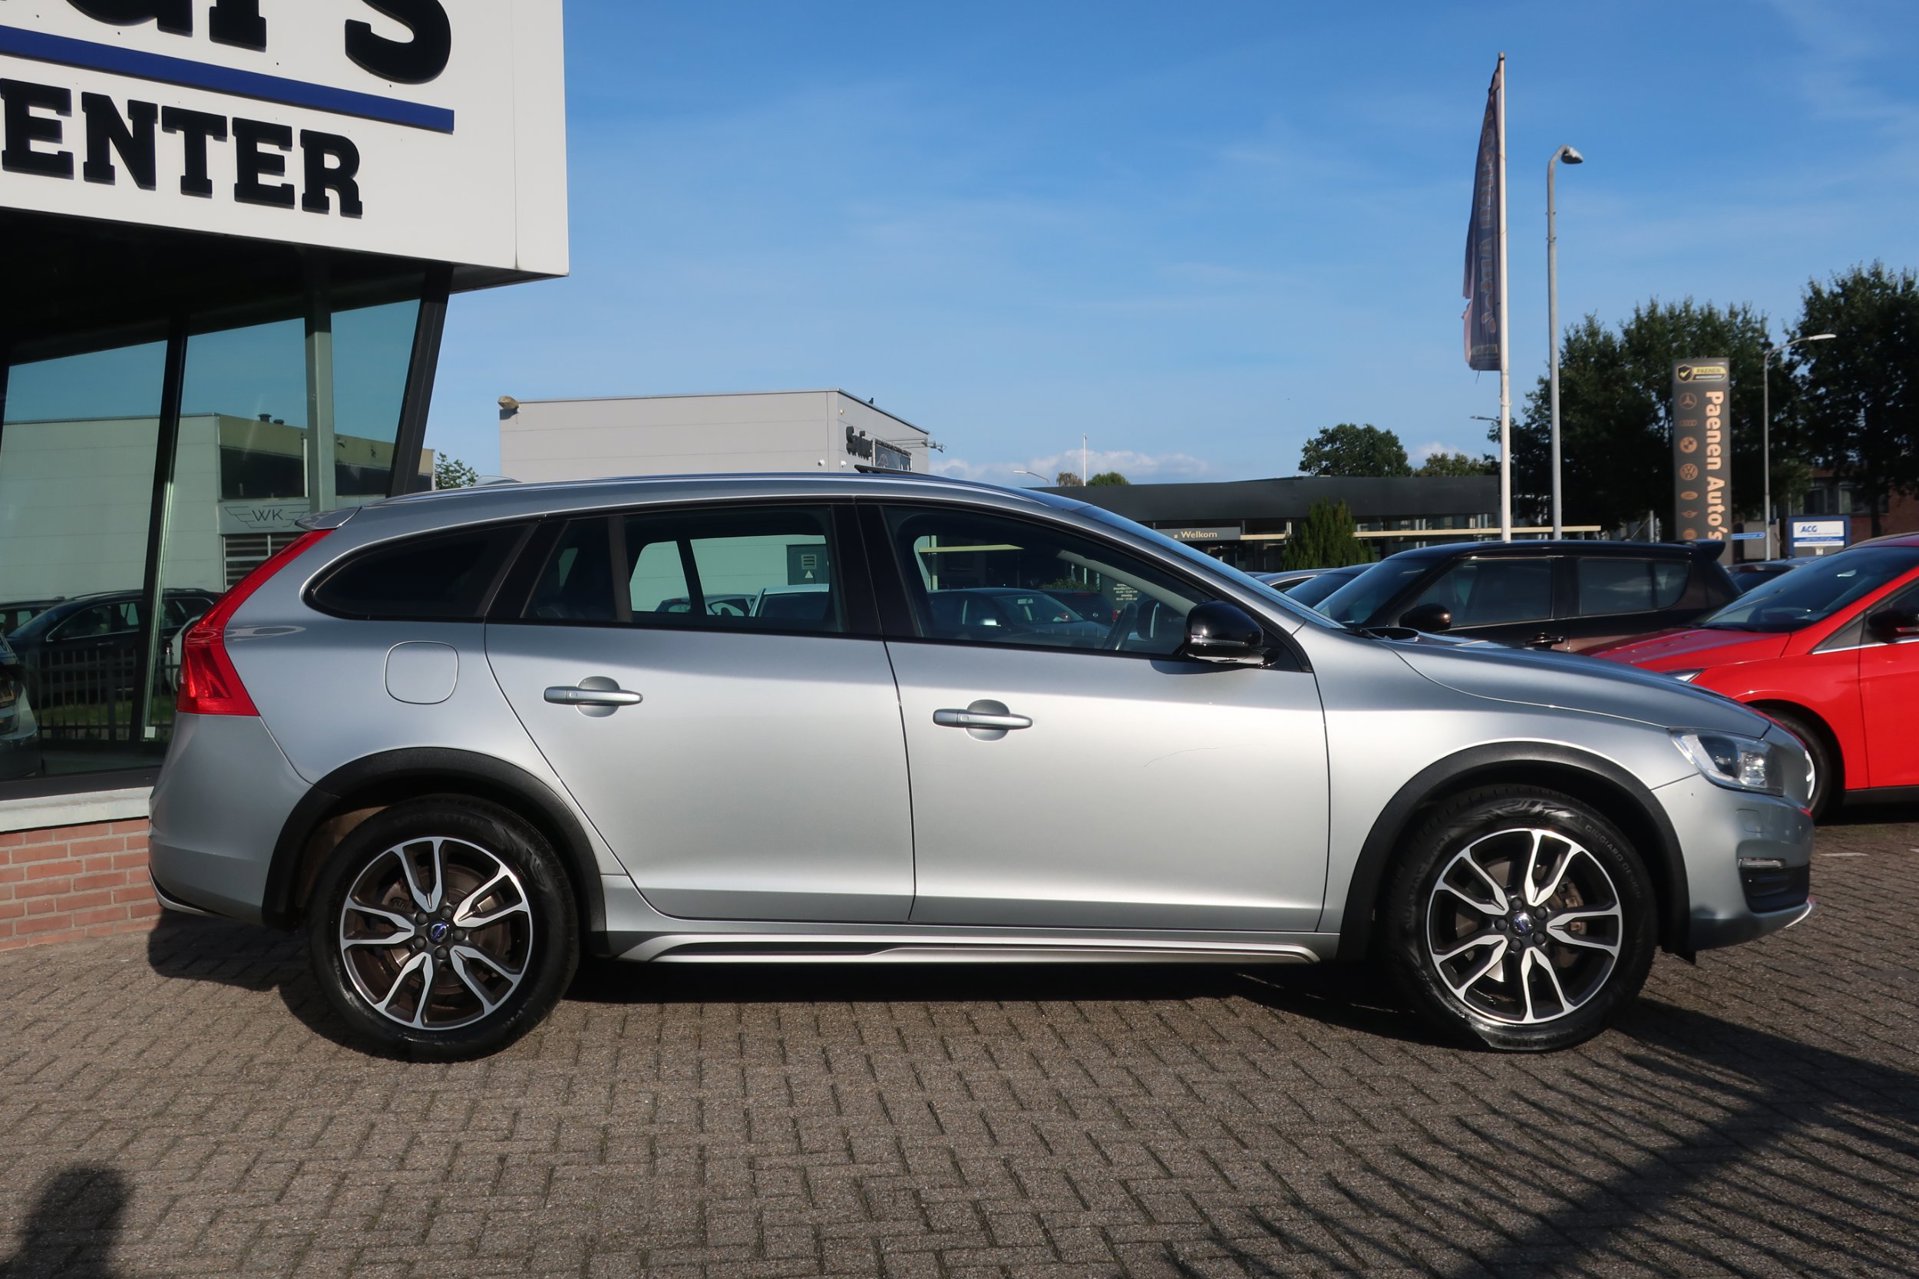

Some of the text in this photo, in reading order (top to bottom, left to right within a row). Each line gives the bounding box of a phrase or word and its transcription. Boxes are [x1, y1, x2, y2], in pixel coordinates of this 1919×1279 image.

[1705, 391, 1725, 471] Paenen
[251, 508, 284, 522] WK
[1706, 475, 1729, 541] Auto's
[1180, 530, 1218, 539] Welkom
[1801, 525, 1817, 533] ACG
